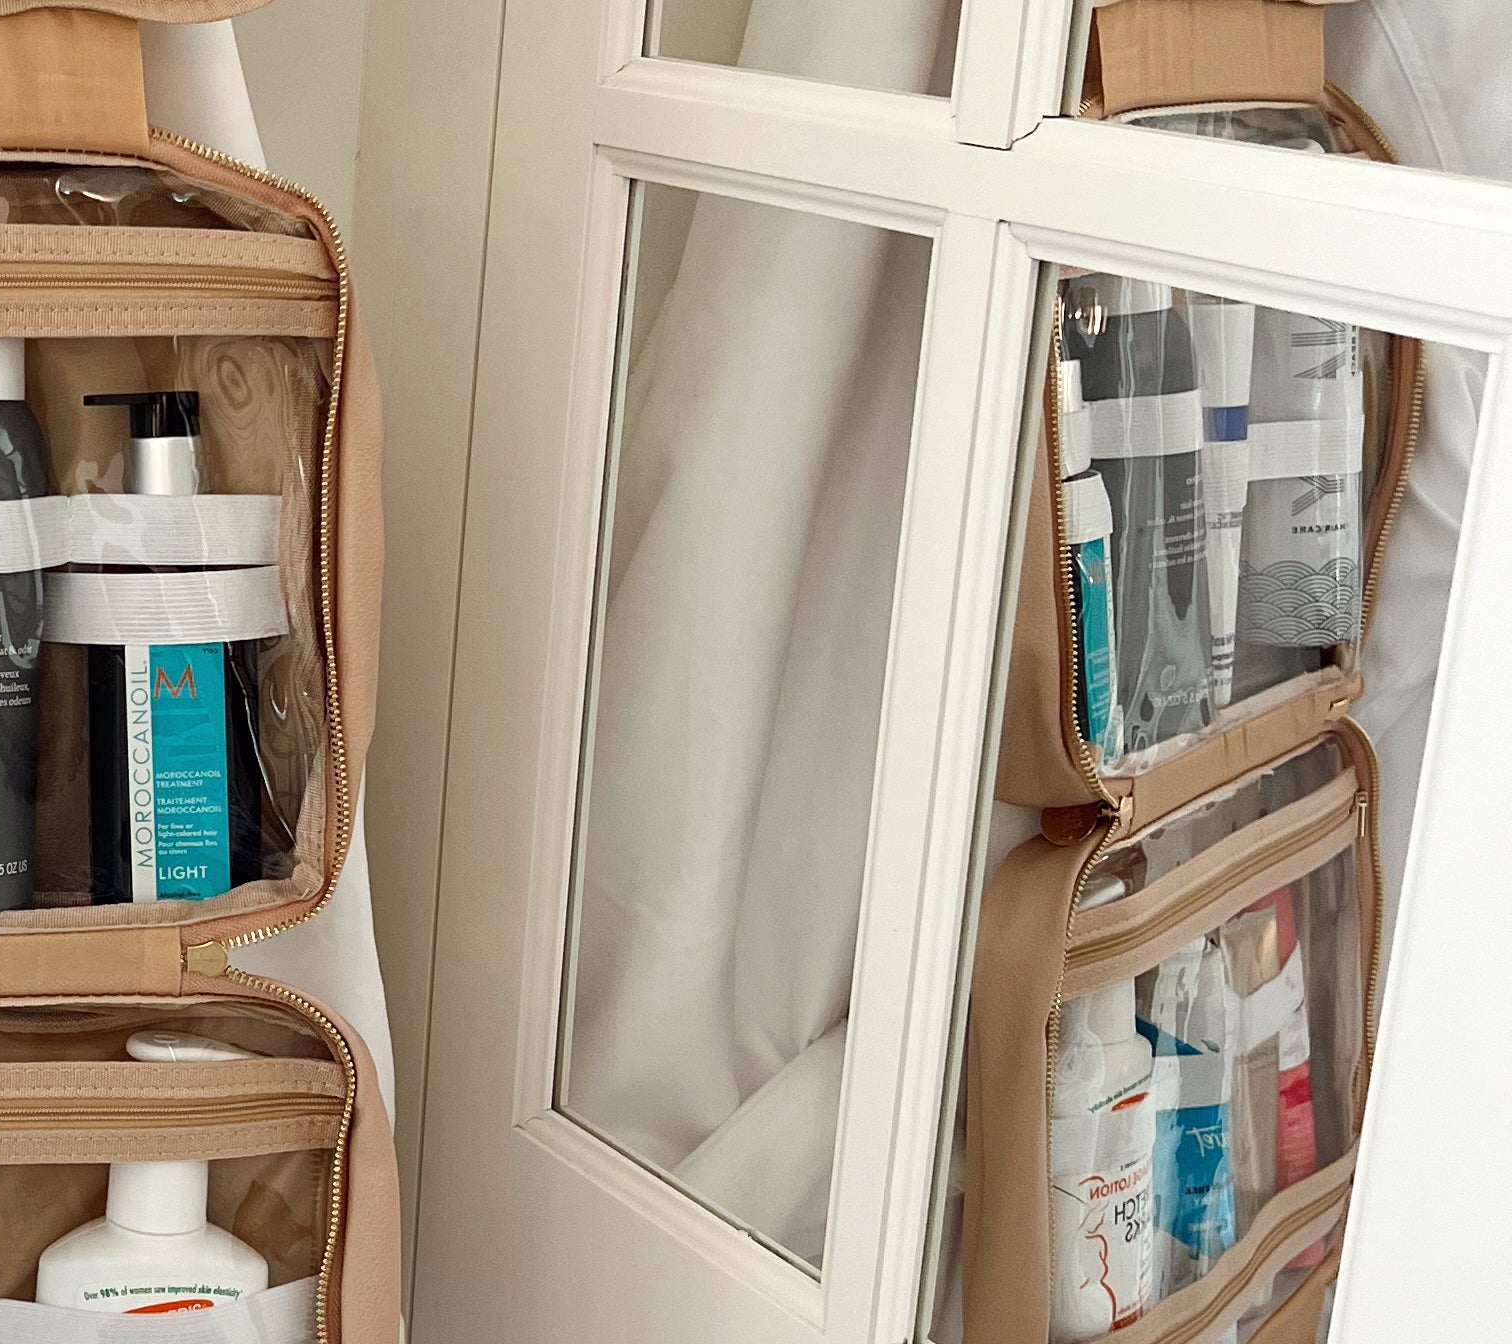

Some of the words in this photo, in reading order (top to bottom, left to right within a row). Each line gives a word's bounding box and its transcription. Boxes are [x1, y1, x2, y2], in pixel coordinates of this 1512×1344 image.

[155, 663, 196, 699] M
[6, 862, 18, 874] OZ
[159, 865, 208, 880] LIGHT
